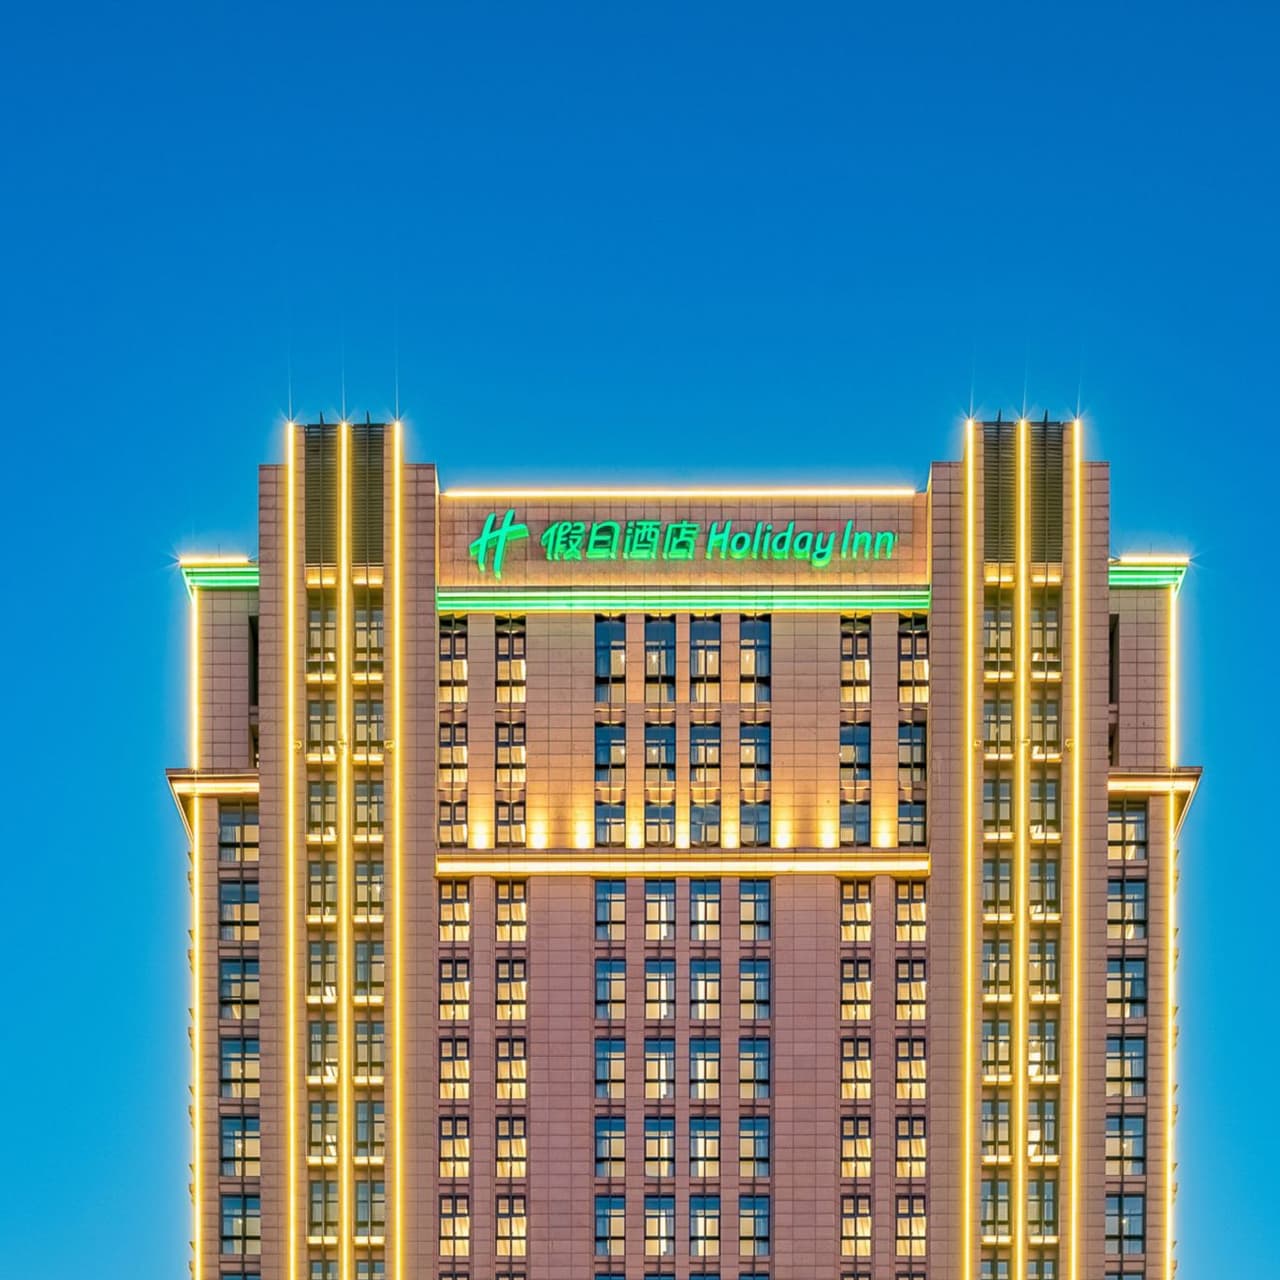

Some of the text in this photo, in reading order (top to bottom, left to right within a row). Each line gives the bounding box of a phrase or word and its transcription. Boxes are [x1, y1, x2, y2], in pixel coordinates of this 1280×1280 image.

[540, 520, 700, 561] 假日酒店
[705, 520, 836, 567] Holiday
[840, 520, 897, 561] Inn
